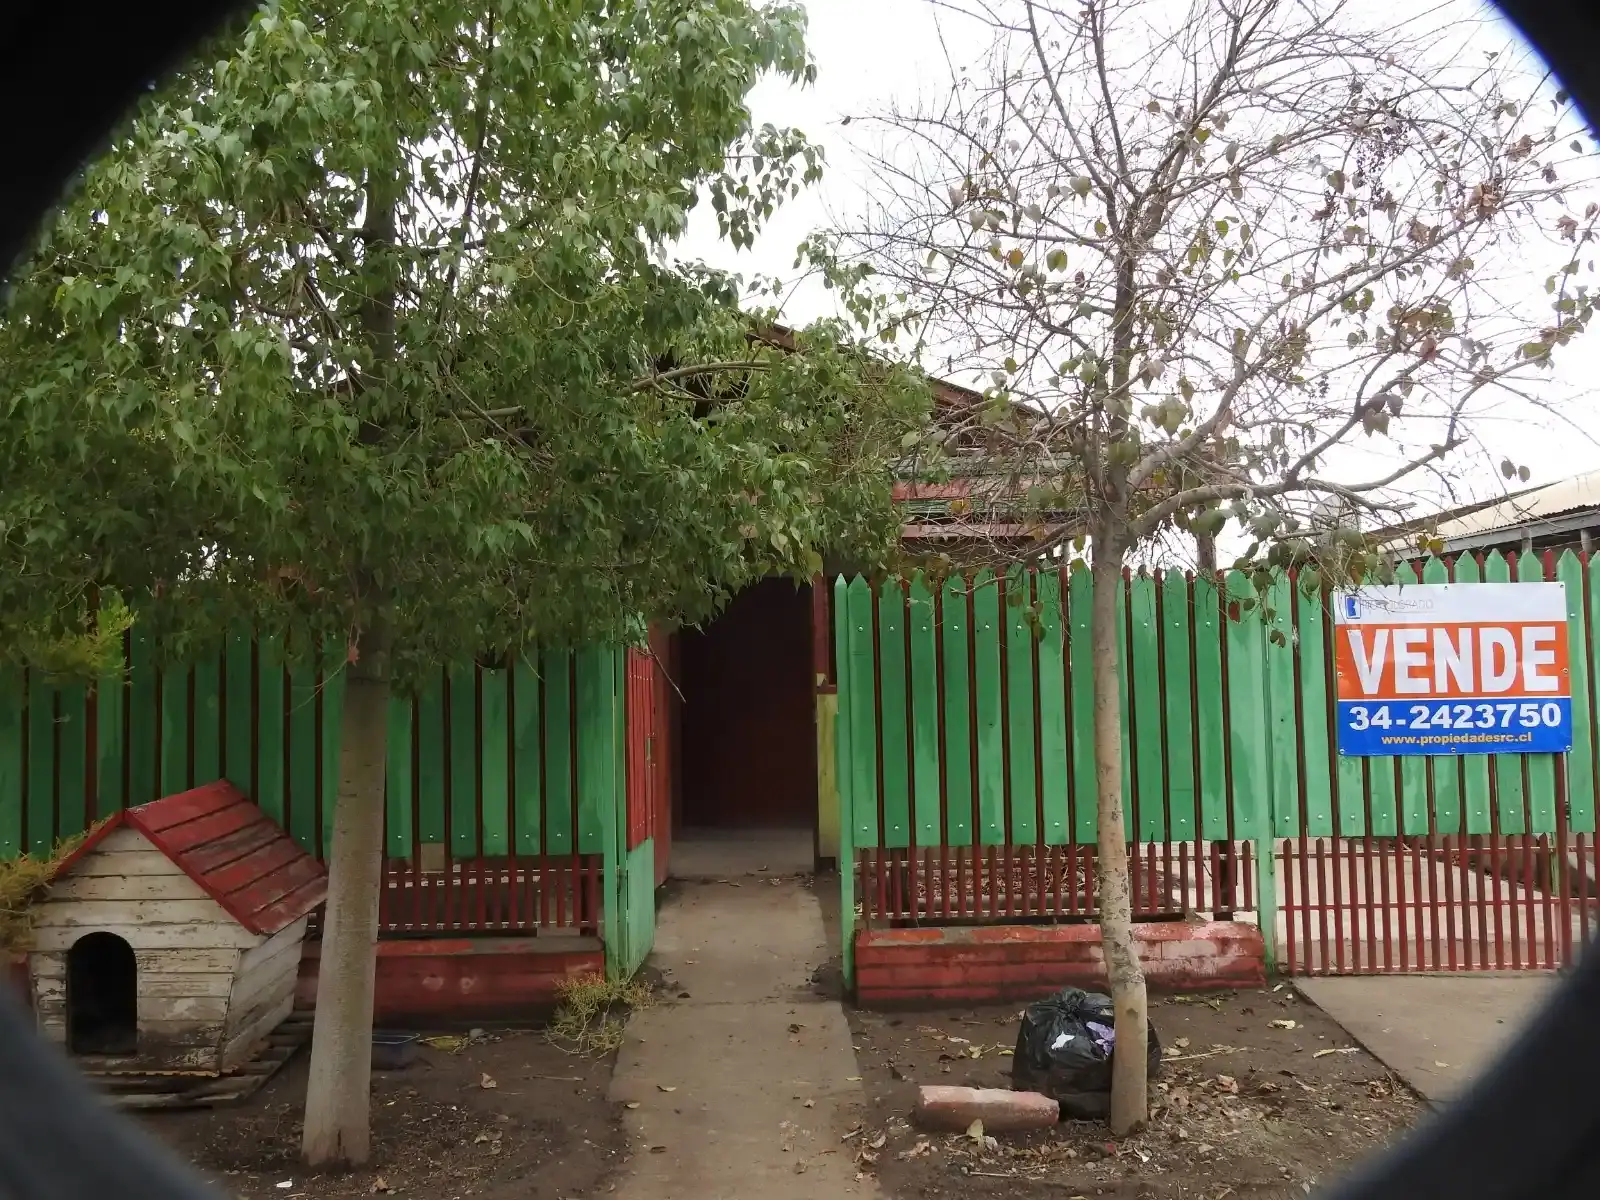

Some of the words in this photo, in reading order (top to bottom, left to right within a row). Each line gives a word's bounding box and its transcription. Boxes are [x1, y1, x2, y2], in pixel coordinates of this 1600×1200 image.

[1347, 627, 1559, 694] VENDE
[1350, 703, 1562, 730] 34-2423750
[1381, 732, 1532, 746] www.propiedadesrc.cl
